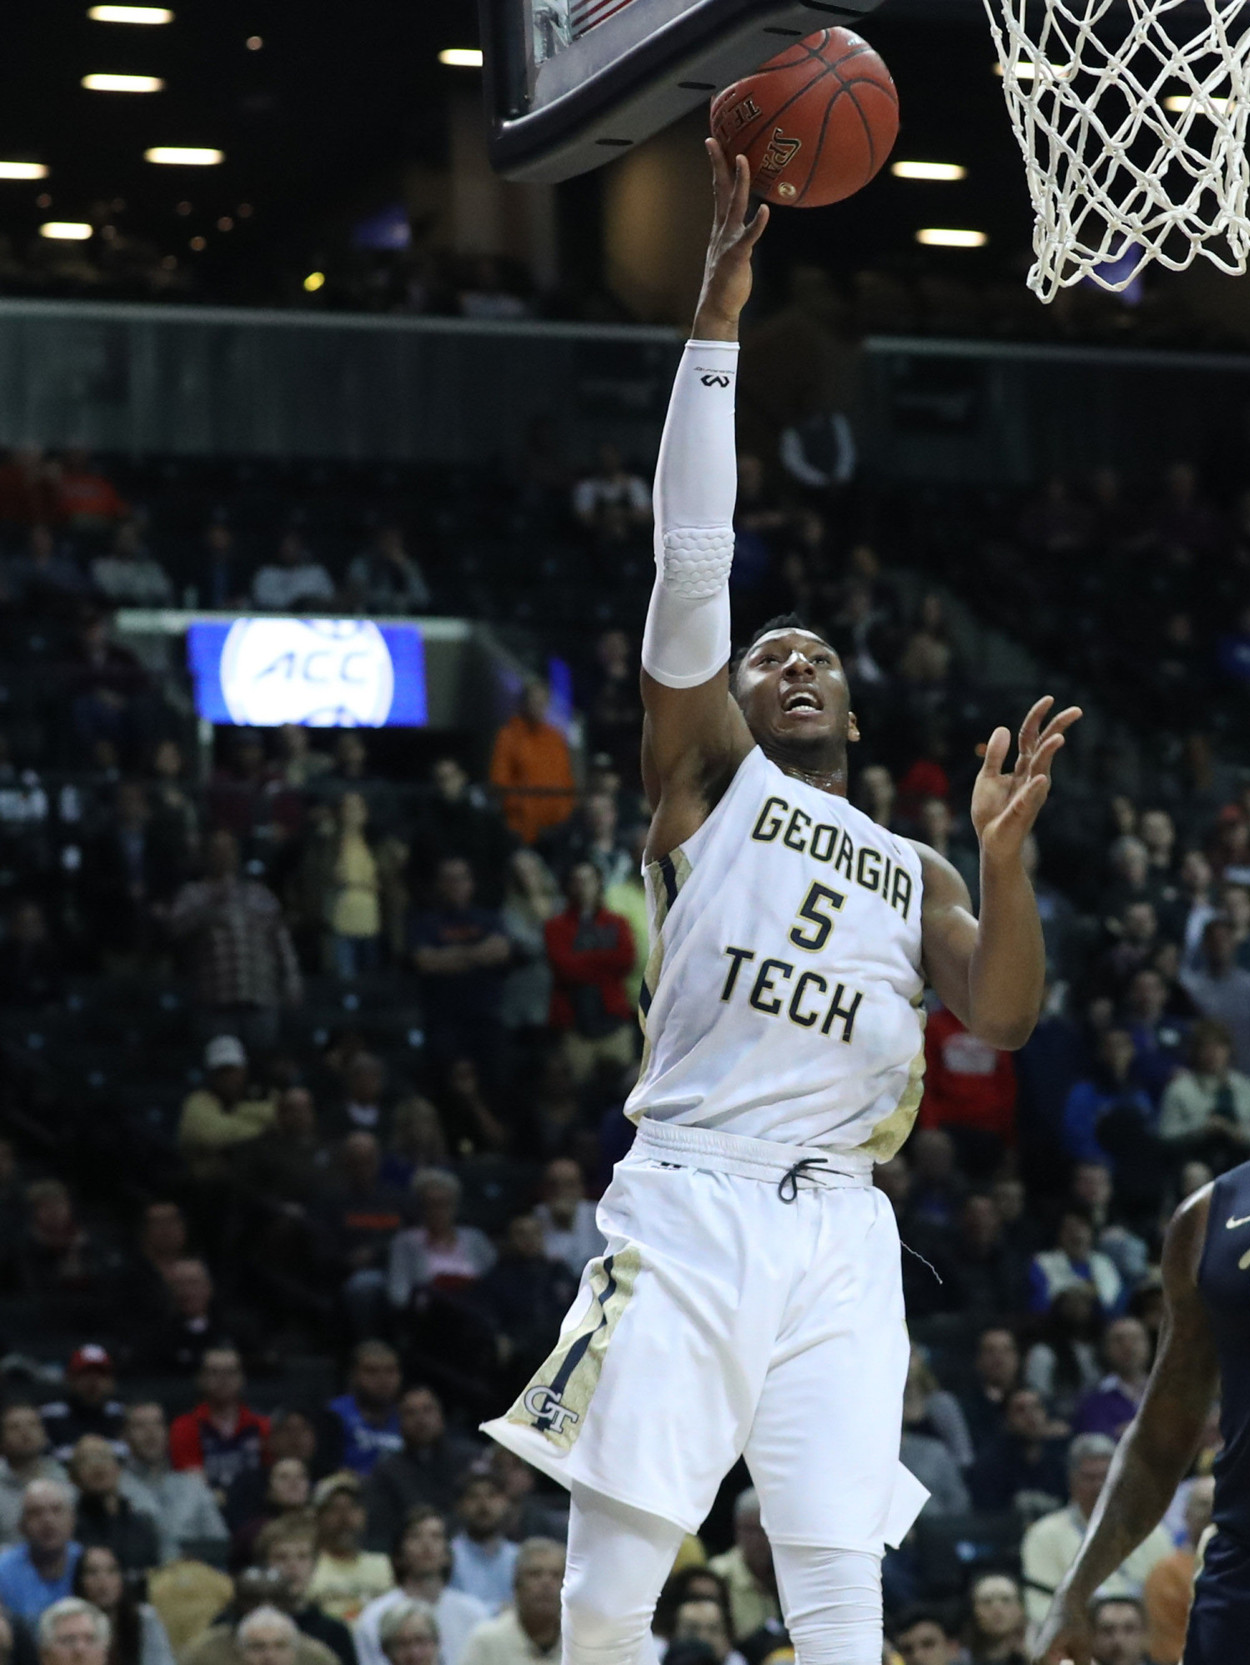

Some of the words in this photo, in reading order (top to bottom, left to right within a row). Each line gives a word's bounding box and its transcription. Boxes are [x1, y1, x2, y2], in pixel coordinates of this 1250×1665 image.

[253, 650, 371, 684] ACC
[751, 795, 913, 921] GEORGIA
[788, 879, 848, 953] 5
[718, 945, 865, 1045] TECH
